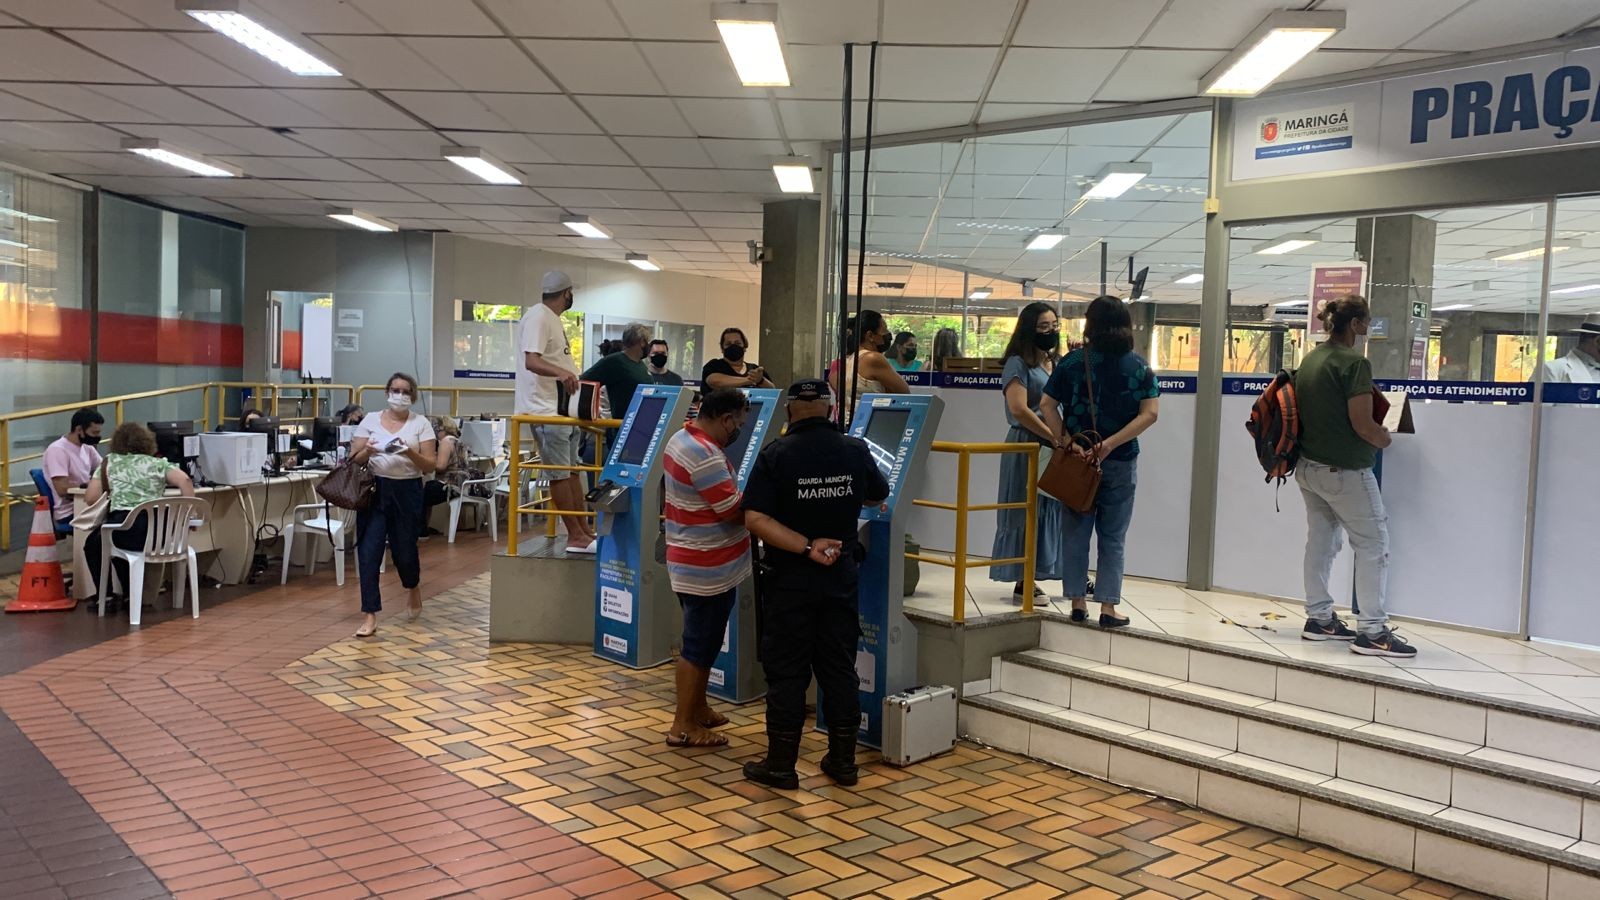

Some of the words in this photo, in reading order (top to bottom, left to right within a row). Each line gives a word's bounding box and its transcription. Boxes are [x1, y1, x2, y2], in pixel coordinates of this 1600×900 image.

[1284, 108, 1348, 131] MARINGÁ
[1283, 130, 1317, 139] PREFEITURA
[1327, 125, 1349, 134] CIDADE
[954, 376, 978, 385] PRAÇA
[1390, 385, 1426, 396] PRAÇA
[1428, 385, 1443, 394] DE
[1444, 386, 1527, 396] ATENDIMENTO
[656, 413, 668, 425] DE
[753, 420, 764, 433] DE
[608, 411, 635, 465] PREFEITURA
[902, 428, 914, 443] DE
[798, 477, 823, 485] GUARDA
[824, 474, 853, 484] MUNICIPAL
[798, 480, 853, 499] MARINGÁ
[31, 576, 50, 588] FT
